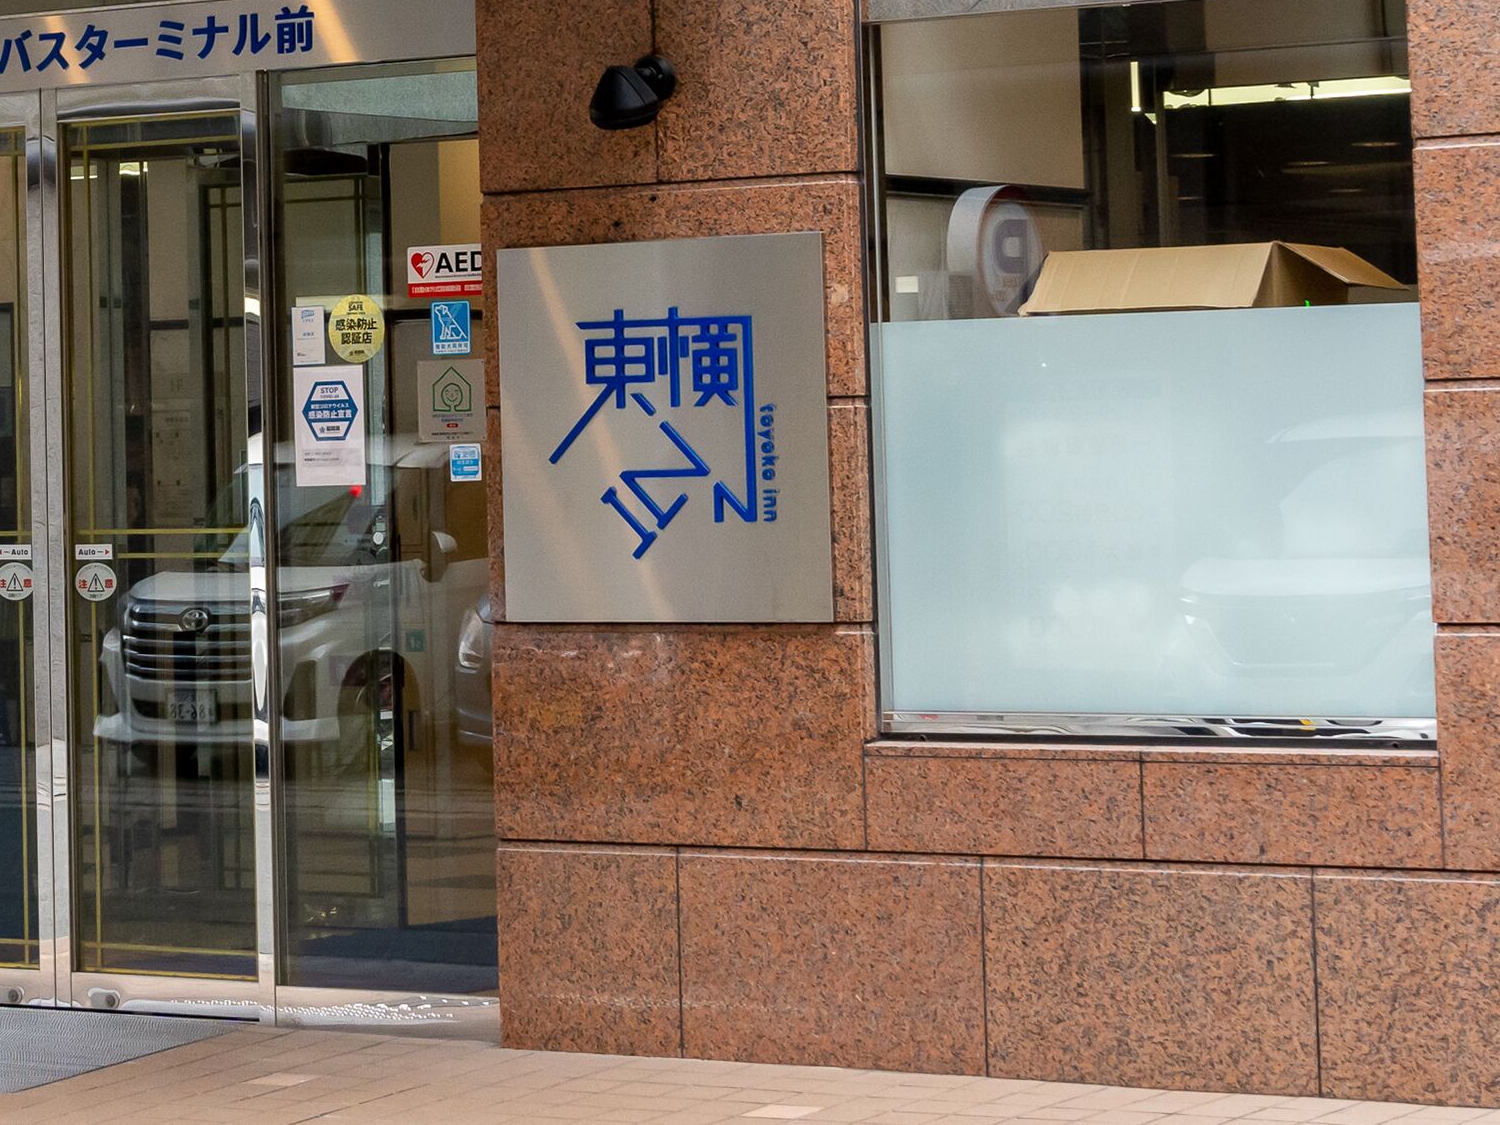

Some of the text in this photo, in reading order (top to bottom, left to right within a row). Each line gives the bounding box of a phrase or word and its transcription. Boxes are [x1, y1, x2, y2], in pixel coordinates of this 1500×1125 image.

[435, 250, 482, 274] AED
[335, 318, 378, 331] 感染防止
[341, 332, 373, 345] 認証店
[757, 403, 778, 523] toyoko inn
[11, 548, 29, 556] Auto
[78, 548, 96, 556] Auto
